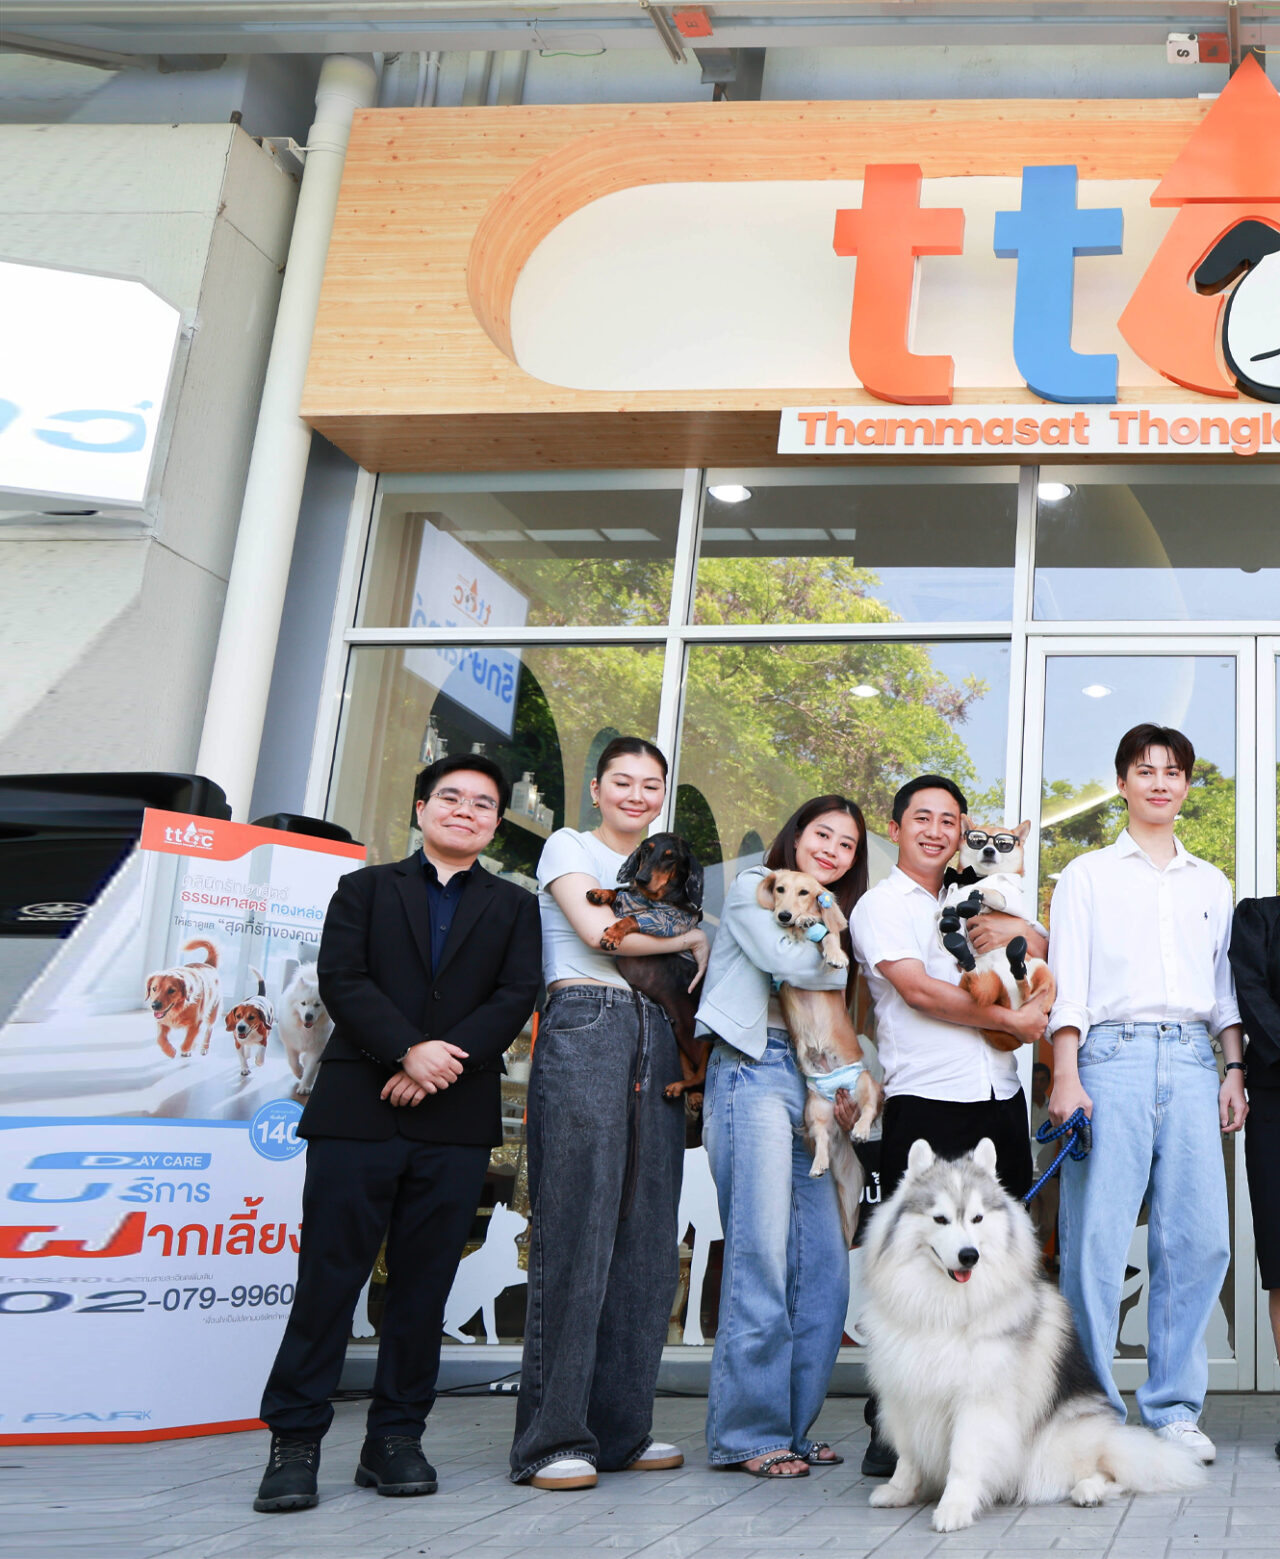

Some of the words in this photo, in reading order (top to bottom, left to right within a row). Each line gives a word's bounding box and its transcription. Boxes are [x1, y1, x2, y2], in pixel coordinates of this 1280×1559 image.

[1176, 48, 1190, 58] S
[798, 411, 1090, 447] Thammasat
[181, 891, 268, 912] ธรรมศาสตร์
[270, 902, 324, 921] ทองหล่อ
[81, 1155, 161, 1166] DAY
[162, 1156, 203, 1167] CARE
[6, 1177, 211, 1203] บริการ
[0, 1283, 295, 1315] 02-079-9960
[21, 1409, 152, 1423] PARK
